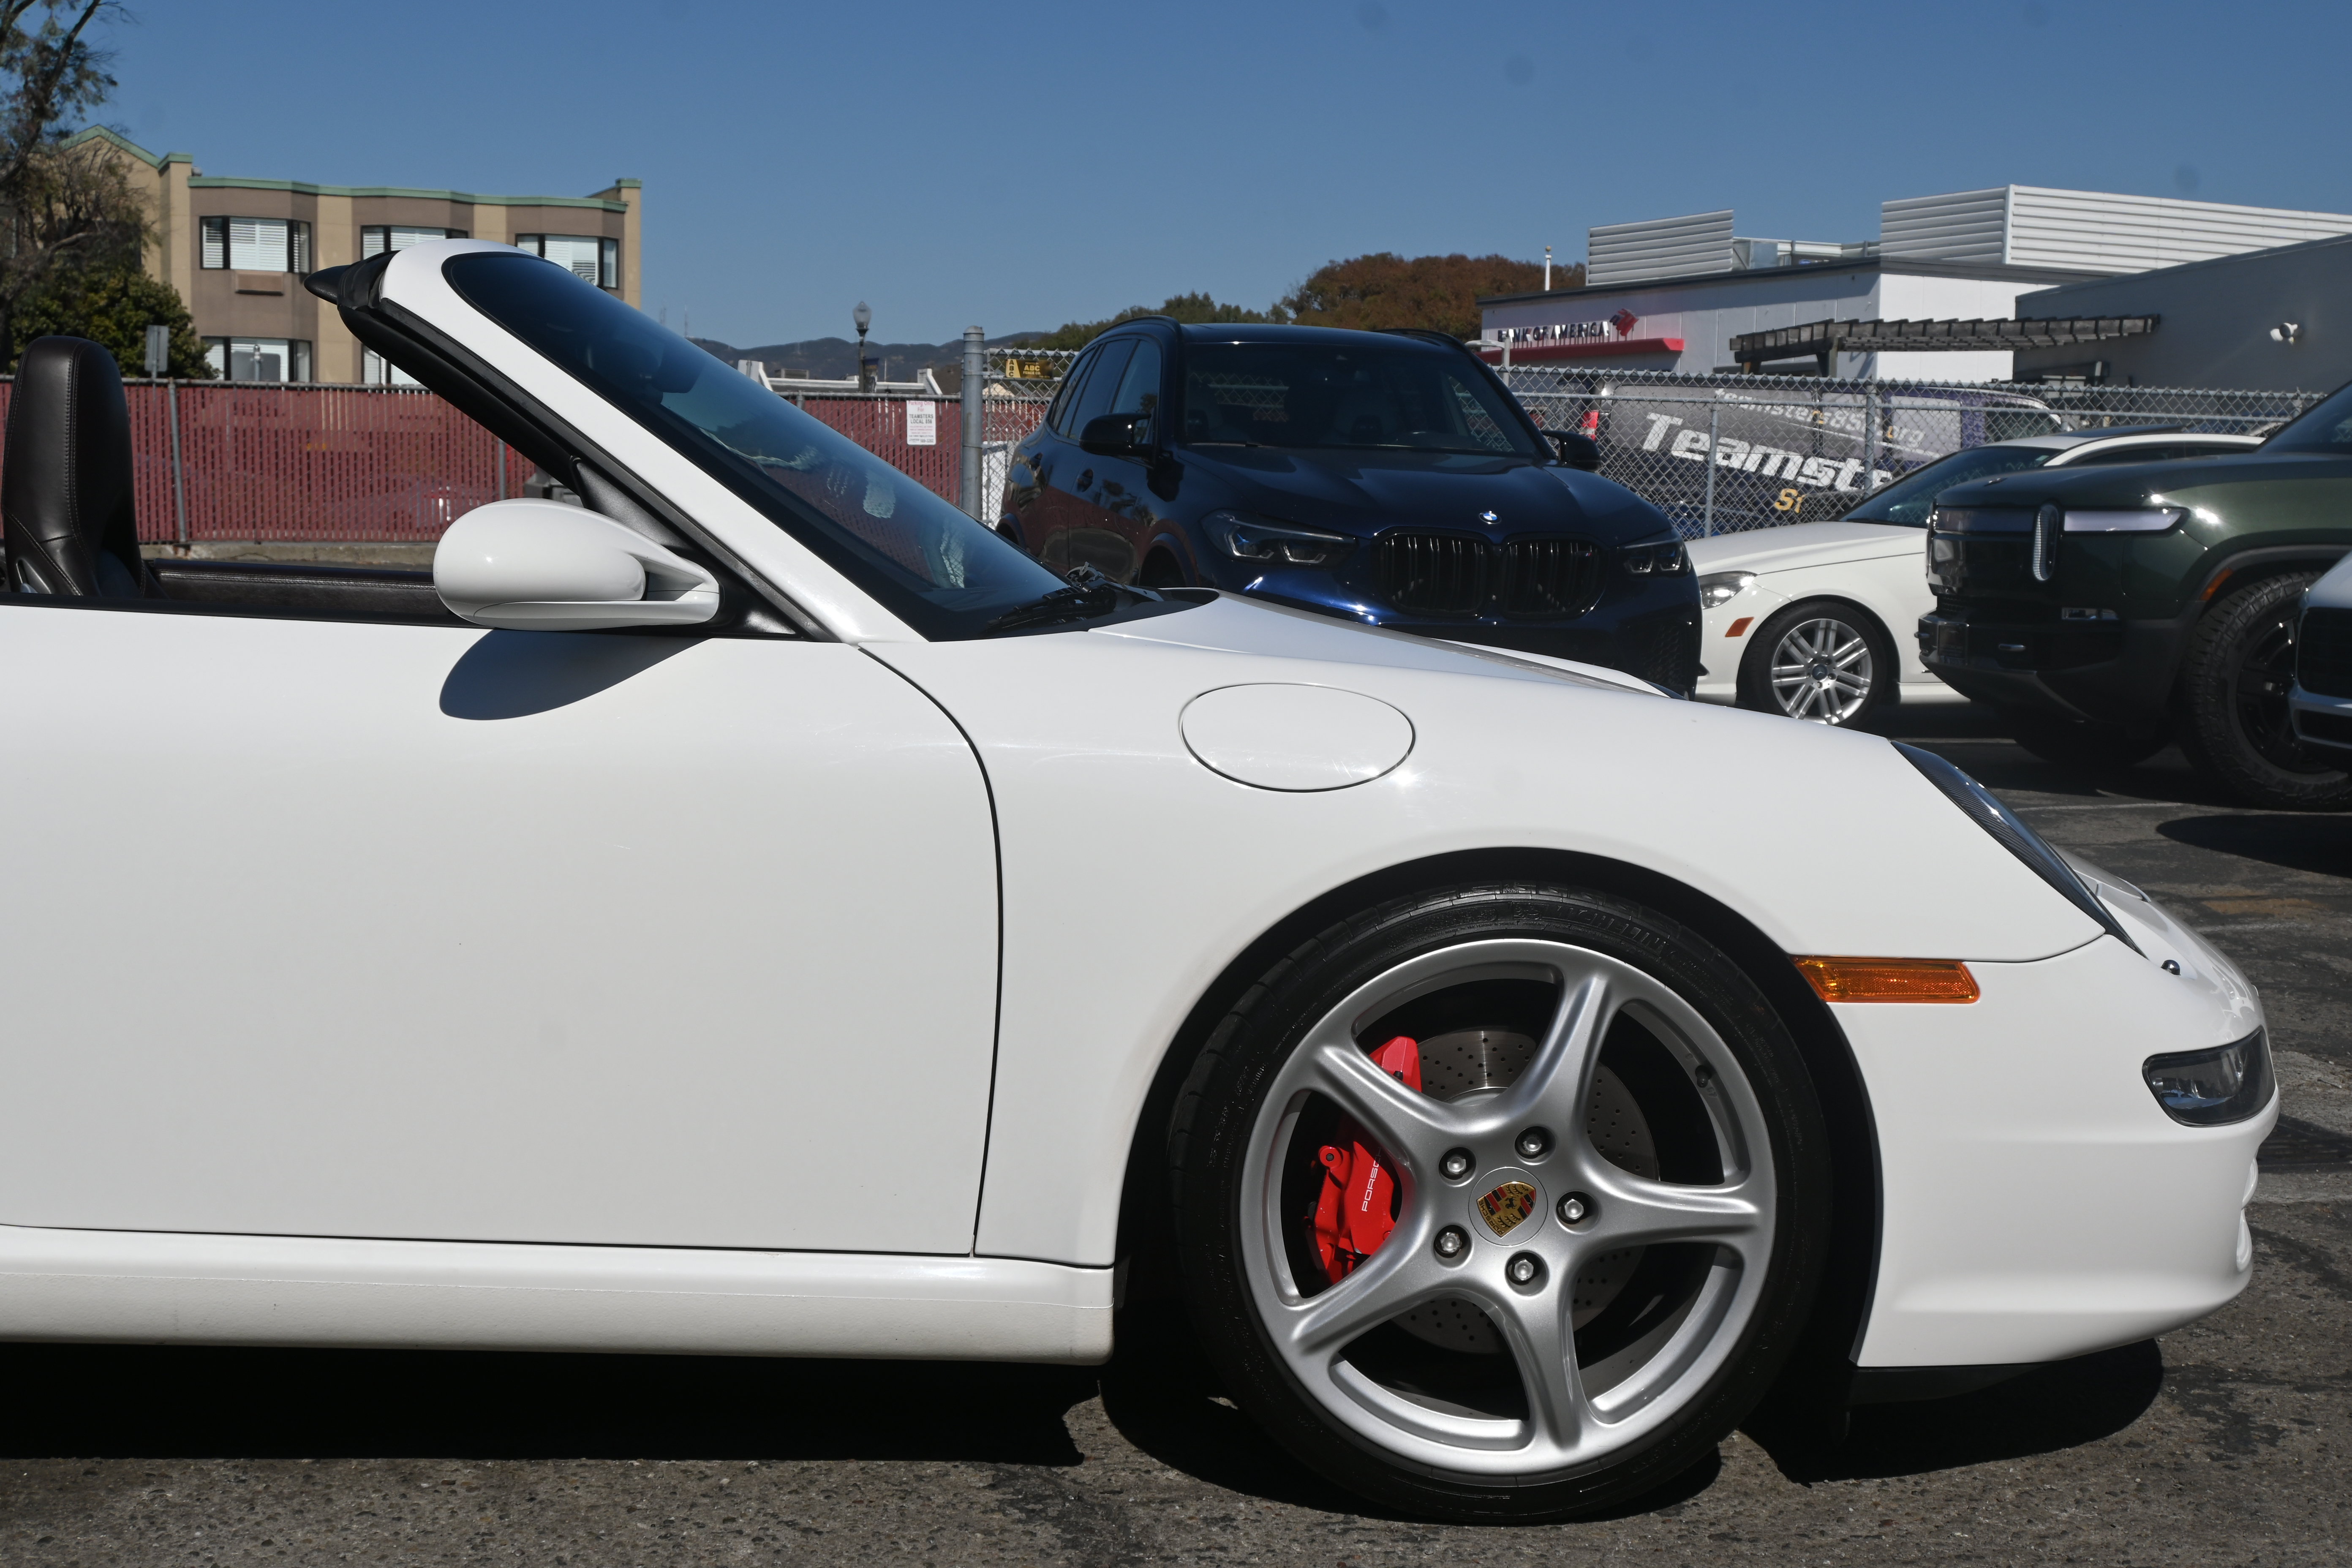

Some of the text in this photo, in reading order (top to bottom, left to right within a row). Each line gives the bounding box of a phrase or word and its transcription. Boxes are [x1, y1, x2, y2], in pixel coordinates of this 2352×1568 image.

[1533, 326, 1550, 340] OF
[1550, 321, 1609, 339] AMERICA
[1479, 1200, 1504, 1235] PORSCHE
